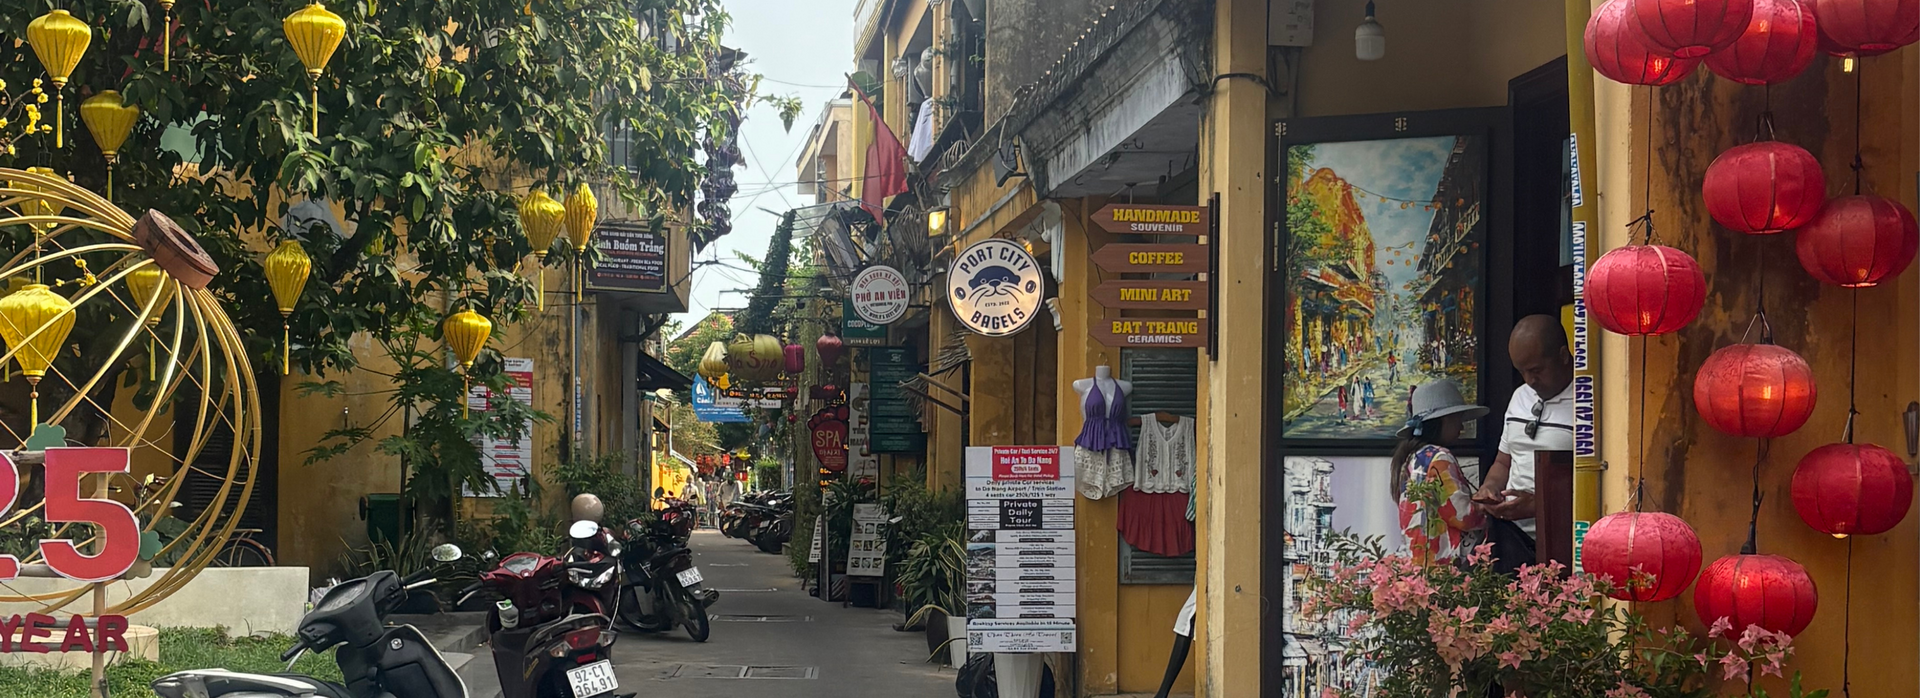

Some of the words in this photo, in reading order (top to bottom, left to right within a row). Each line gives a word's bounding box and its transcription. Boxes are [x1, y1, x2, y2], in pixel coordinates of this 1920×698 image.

[1112, 208, 1200, 223] HANDMADE
[1130, 223, 1183, 232] SOUVENIR
[959, 246, 993, 275] PORT
[999, 247, 1031, 272] CITY
[1129, 252, 1184, 265] COFFEE
[874, 291, 885, 301] AN
[1120, 288, 1157, 301] MINI
[1160, 289, 1192, 302] ART
[970, 307, 1025, 330] BAGELS
[1112, 321, 1143, 334] BAT
[1146, 321, 1198, 334] TRANG
[1127, 335, 1183, 343] CERAMICS
[815, 430, 842, 448] SPA
[1003, 500, 1038, 508] Private
[0, 447, 140, 582] 5
[1008, 508, 1033, 517] Daily
[575, 676, 614, 697] 364.91
